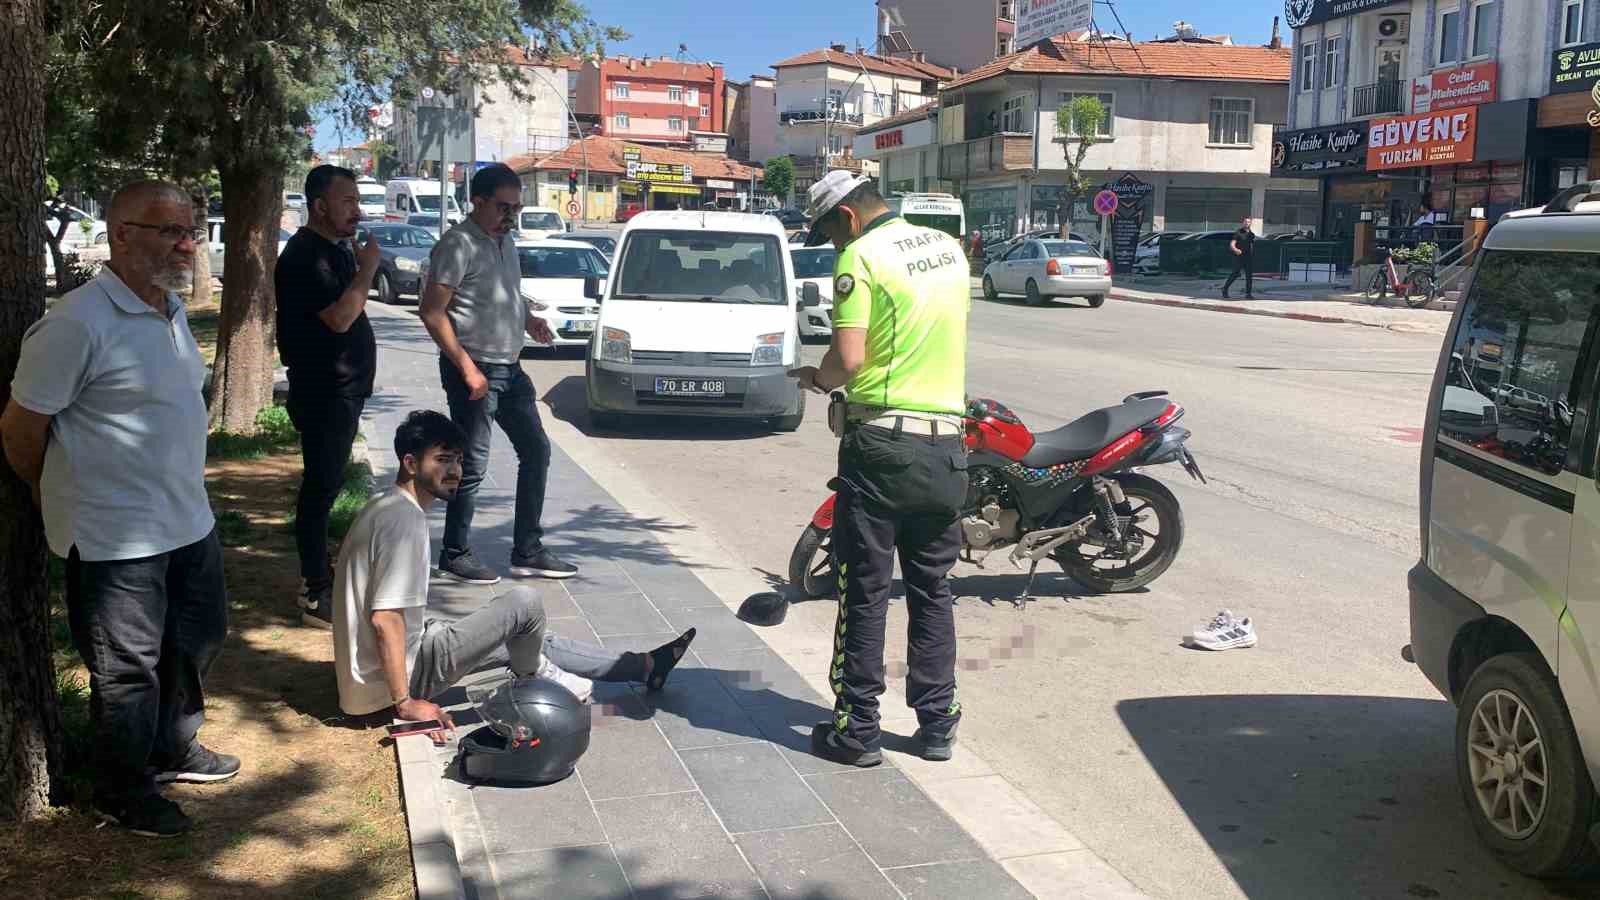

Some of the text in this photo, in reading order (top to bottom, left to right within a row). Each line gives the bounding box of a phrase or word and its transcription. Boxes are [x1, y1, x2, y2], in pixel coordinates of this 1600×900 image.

[1290, 133, 1322, 152] Hasibe
[662, 380, 722, 392] 70 ER 408
